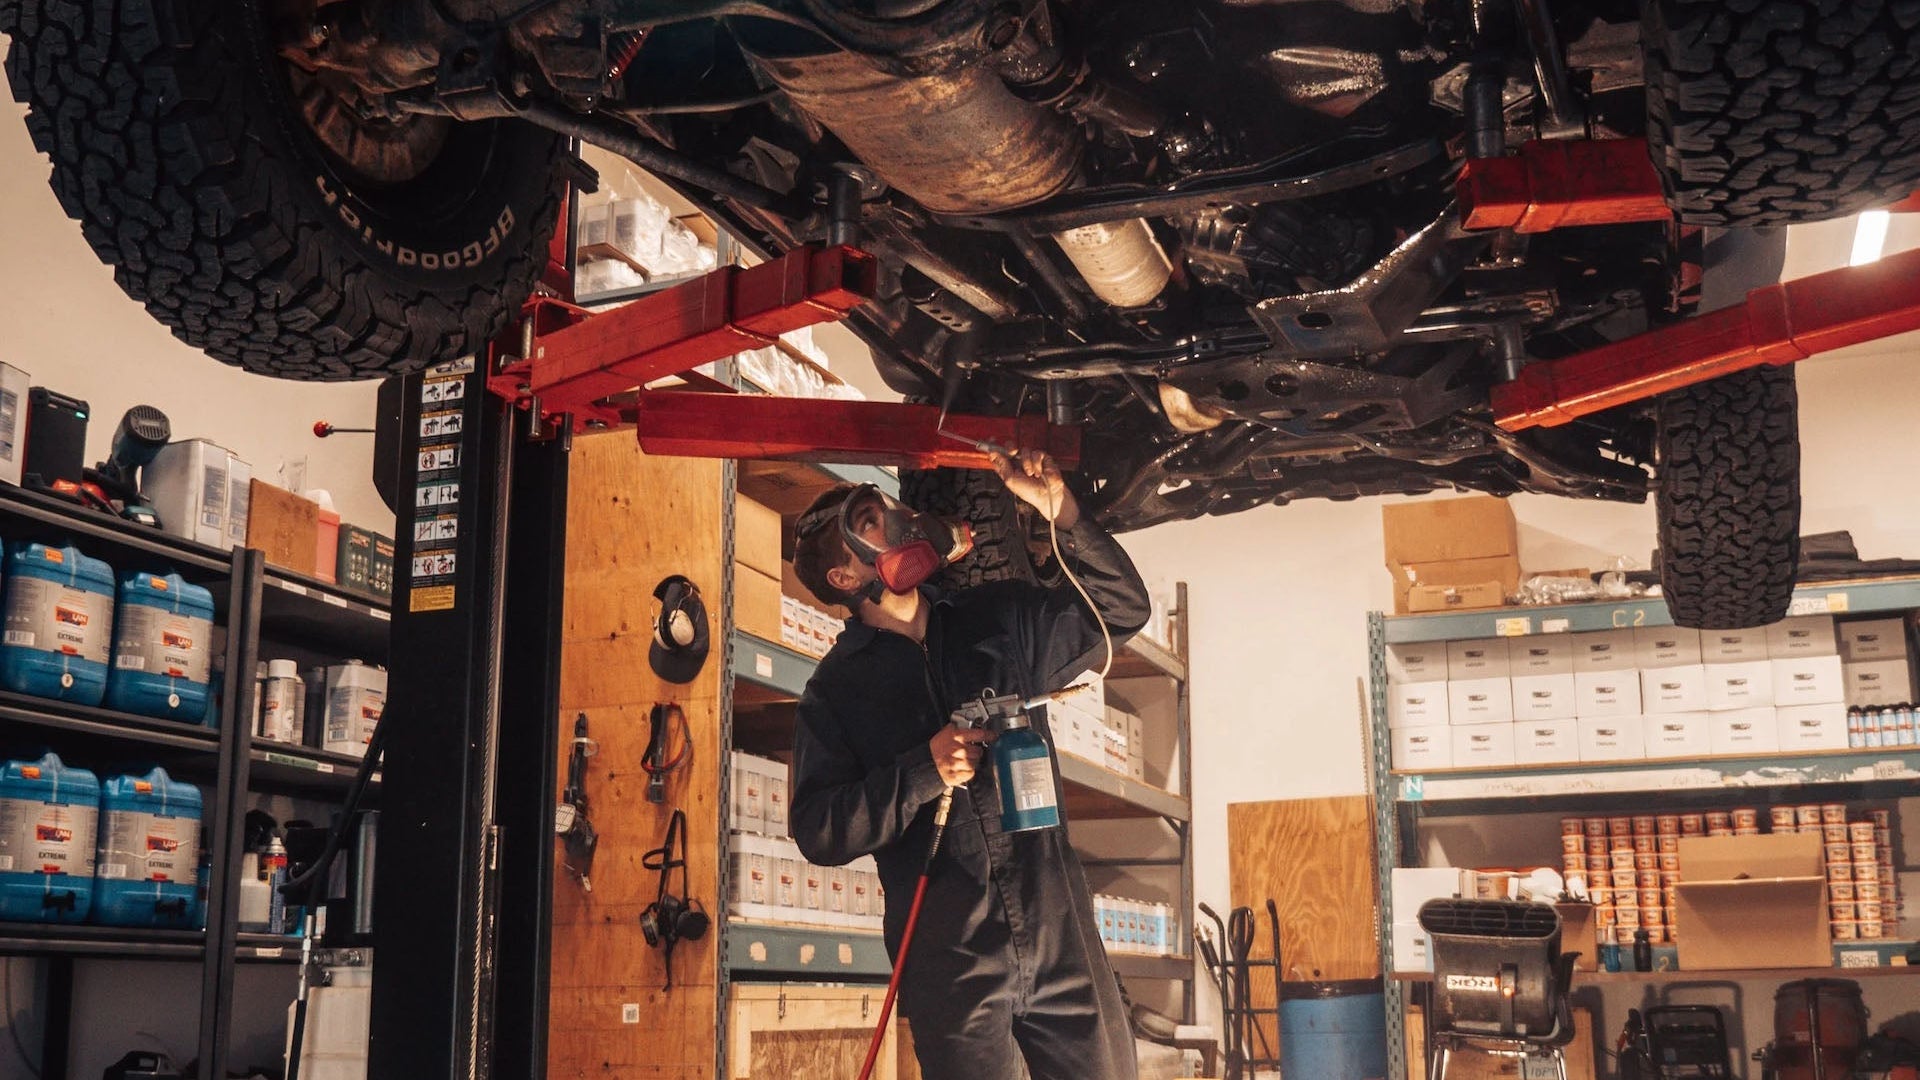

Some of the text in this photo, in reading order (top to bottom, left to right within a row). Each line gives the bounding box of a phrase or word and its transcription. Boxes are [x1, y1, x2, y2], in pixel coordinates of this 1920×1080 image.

[1612, 609, 1645, 628] C 2
[1406, 776, 1422, 793] N
[38, 851, 67, 860] EXTREME
